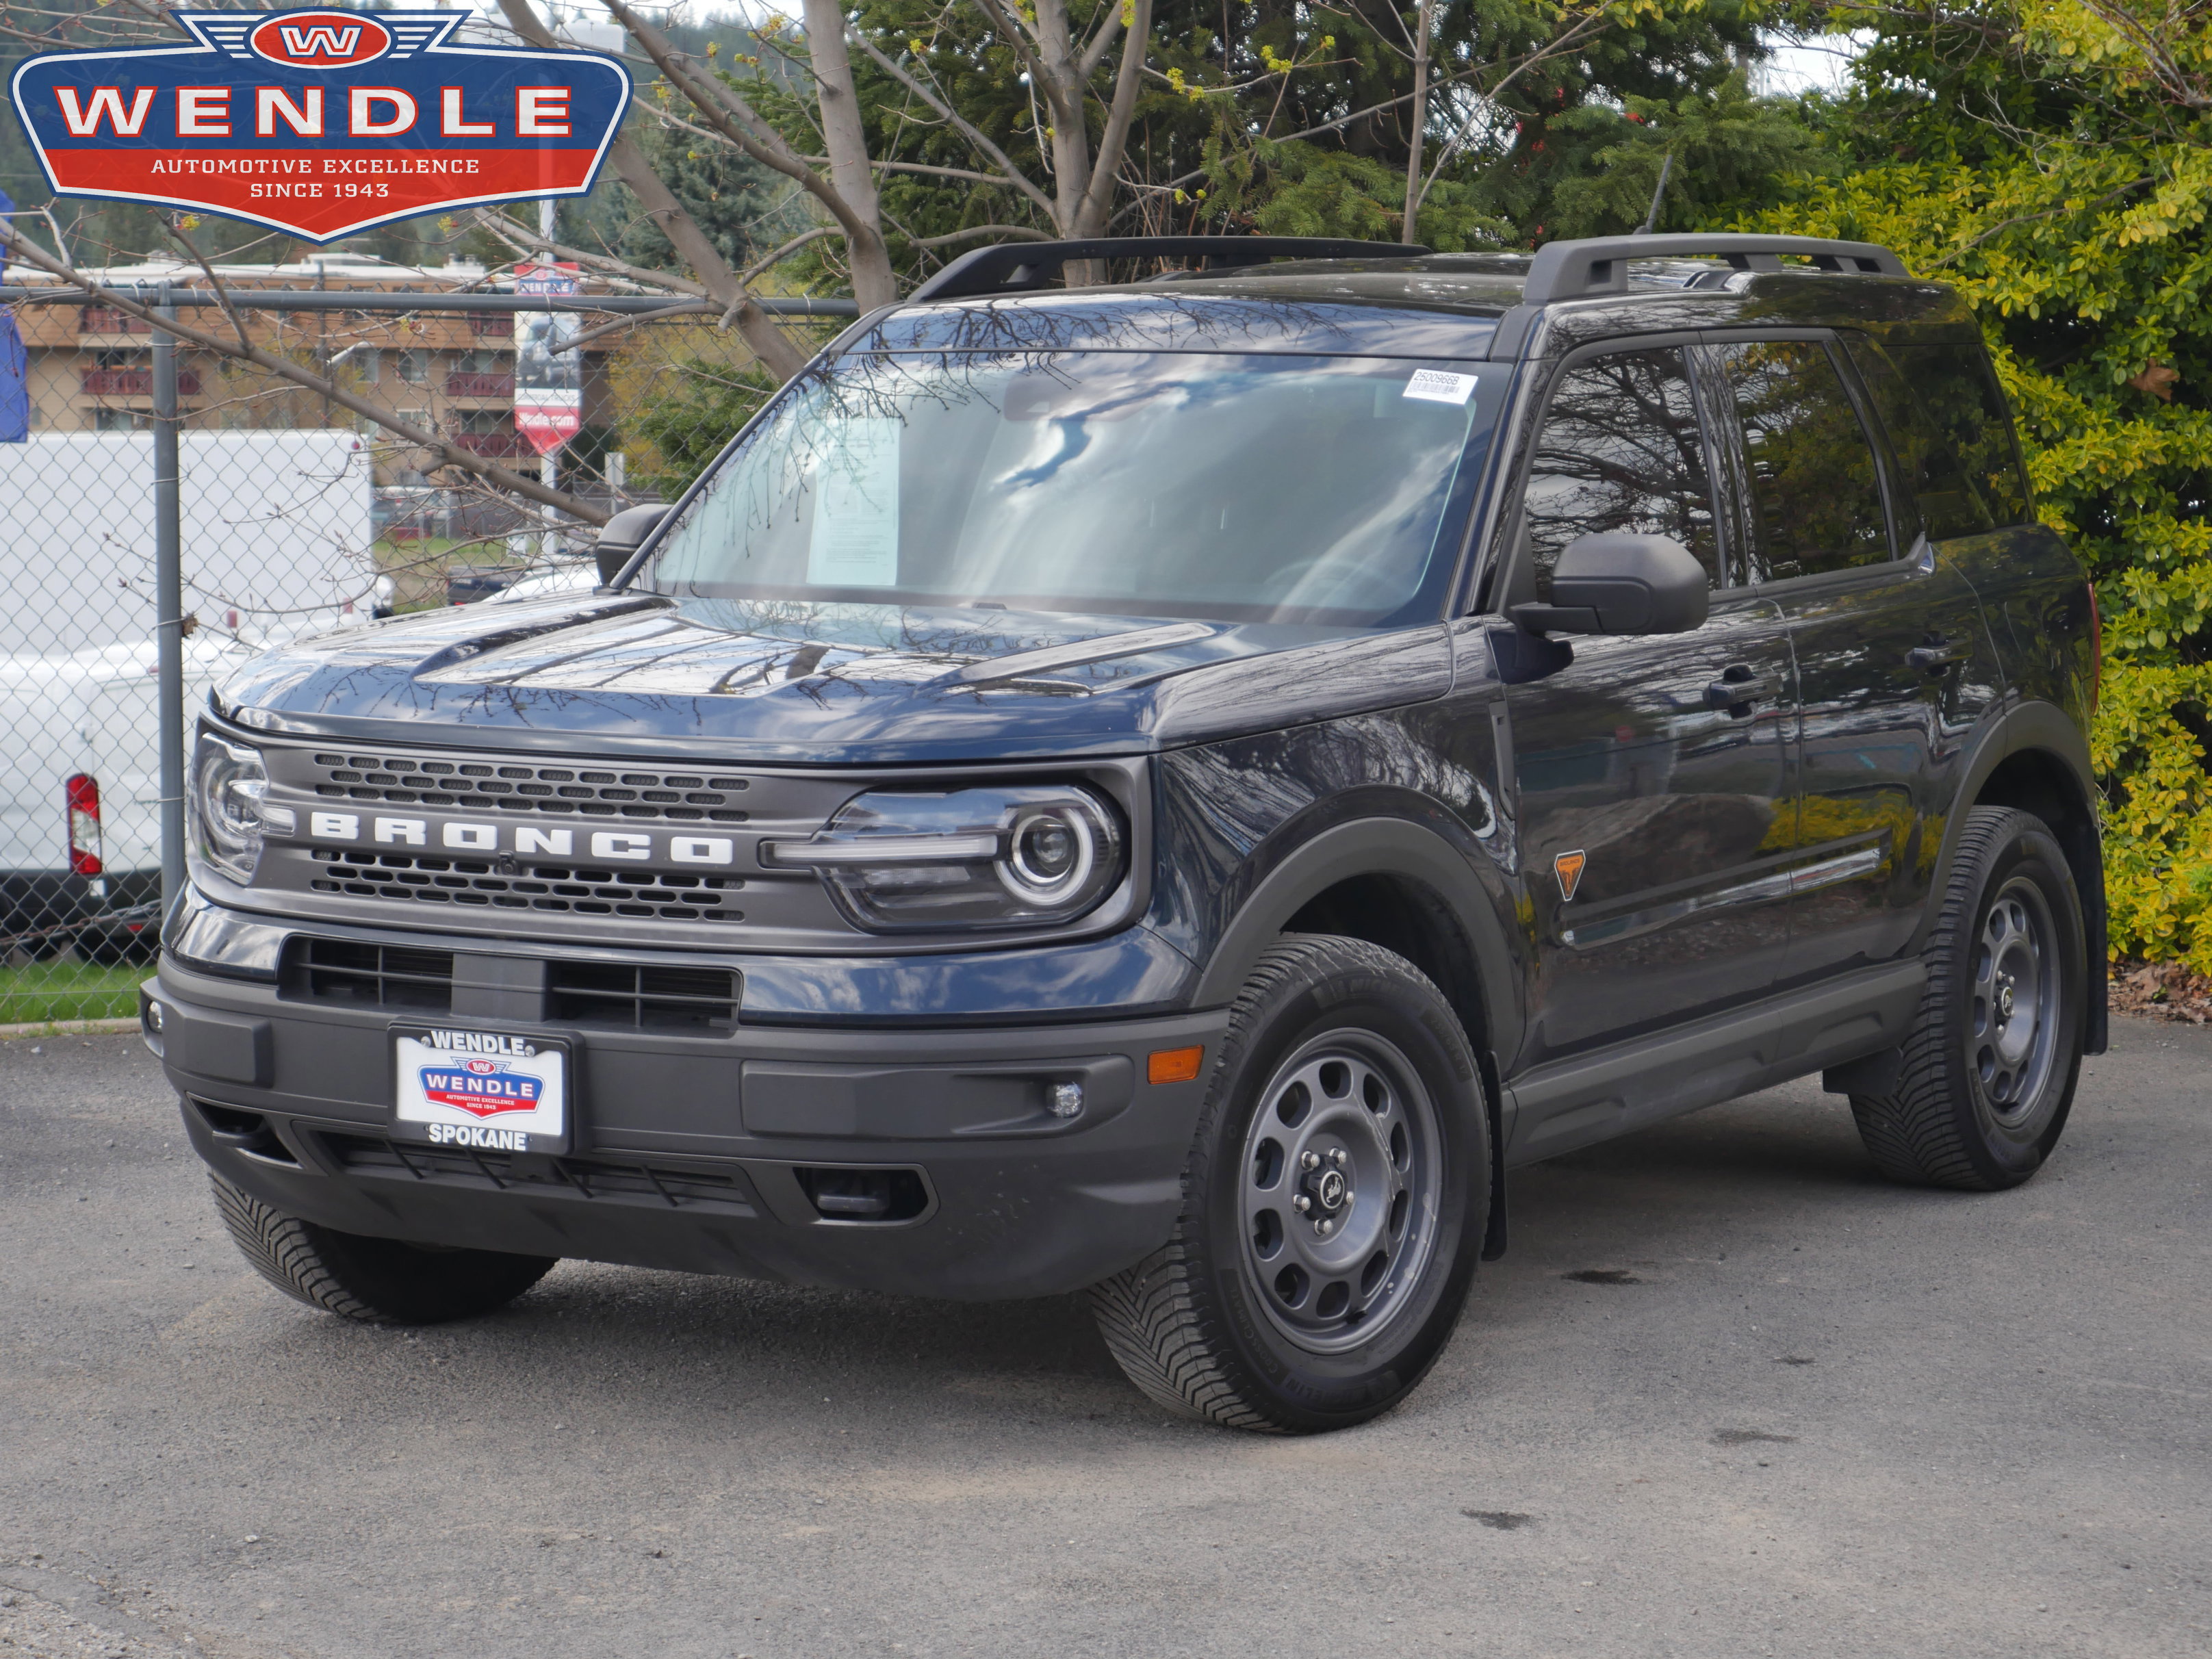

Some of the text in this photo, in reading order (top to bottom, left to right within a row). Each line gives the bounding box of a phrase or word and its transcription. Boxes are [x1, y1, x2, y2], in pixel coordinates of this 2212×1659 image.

[311, 811, 733, 864] BRONCO
[430, 1031, 526, 1057] WENDLE
[426, 1074, 533, 1097] WENDLE
[446, 1094, 515, 1105] AUTOMOTIVE EXCELLENCE
[428, 1123, 526, 1151] SPOKANE
